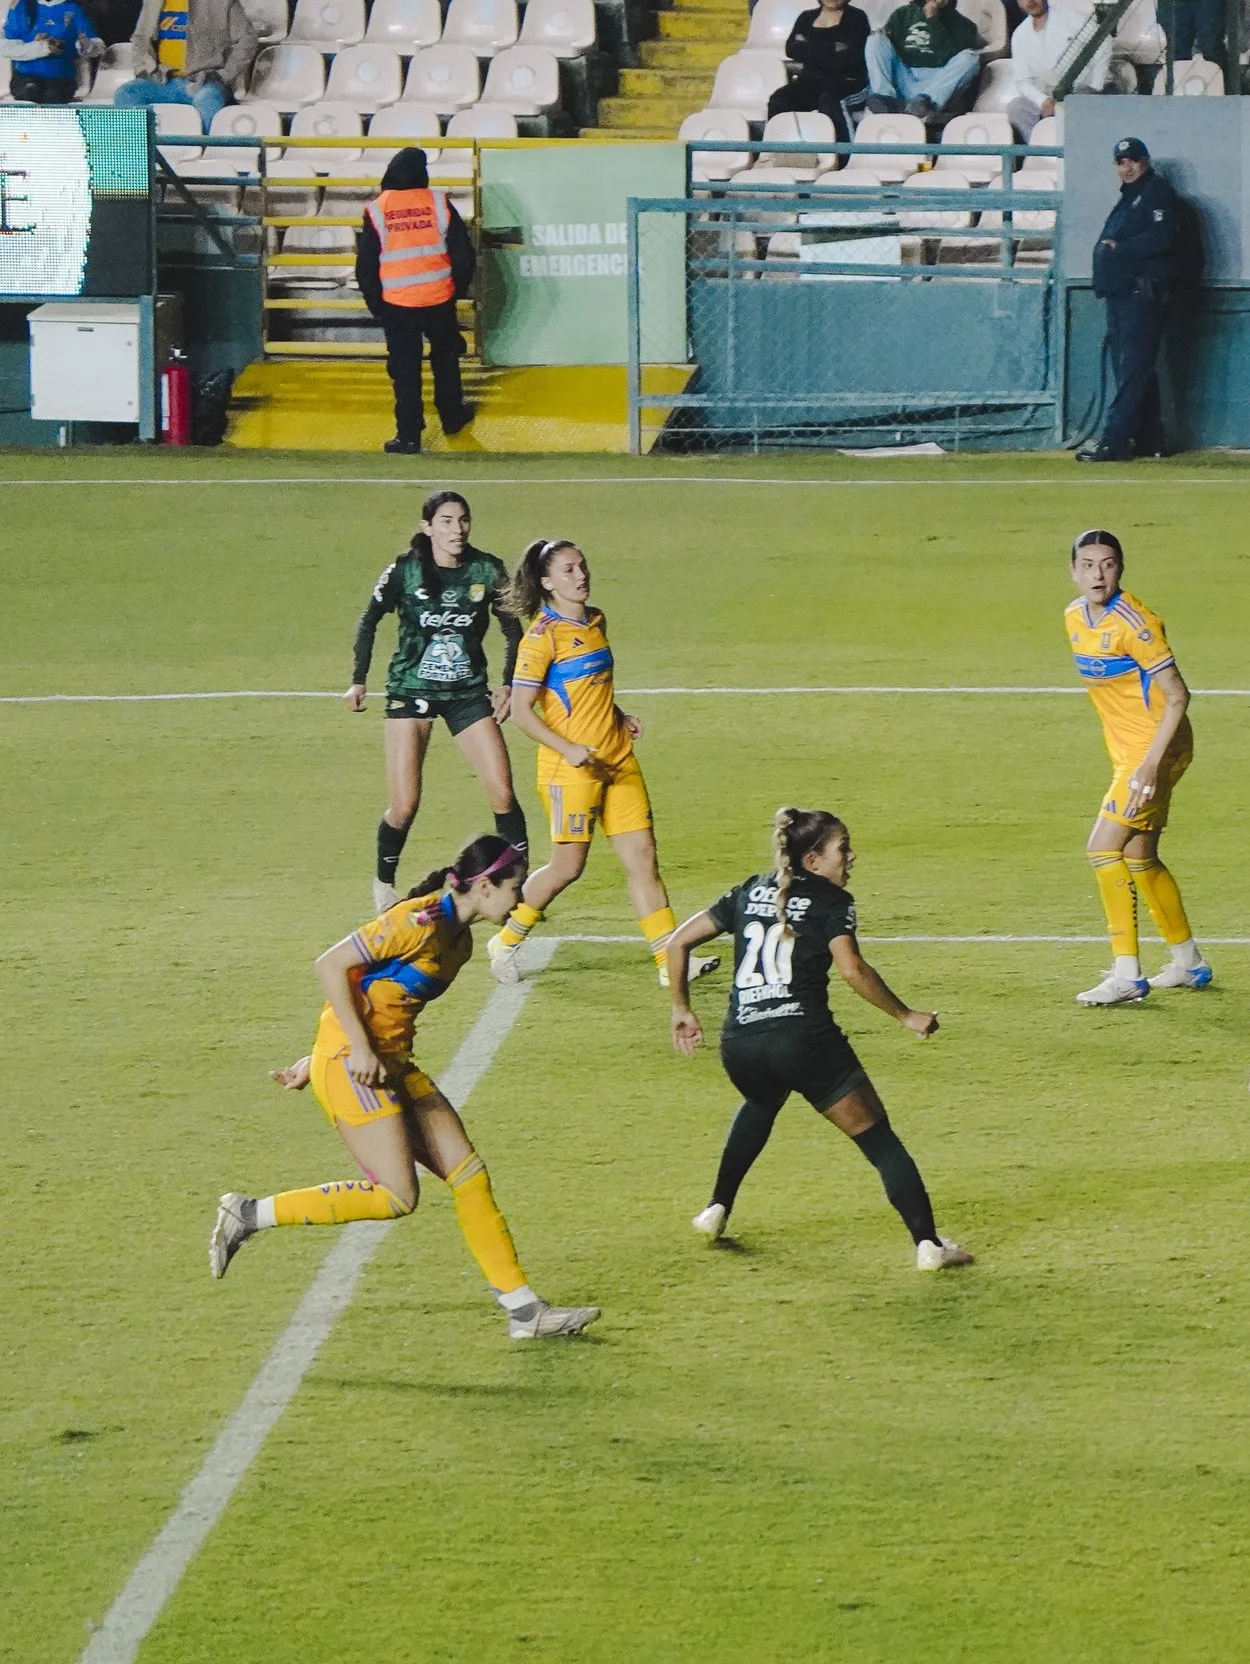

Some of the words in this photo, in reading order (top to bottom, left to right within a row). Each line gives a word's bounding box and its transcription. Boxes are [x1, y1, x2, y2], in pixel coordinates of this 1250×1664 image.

[384, 207, 432, 220] SEGURIDAD
[386, 220, 433, 232] PRIVADA
[531, 223, 601, 246] SALIDA
[520, 252, 644, 277] EMERGENCI
[749, 886, 812, 910] Offce
[735, 921, 795, 988] 20
